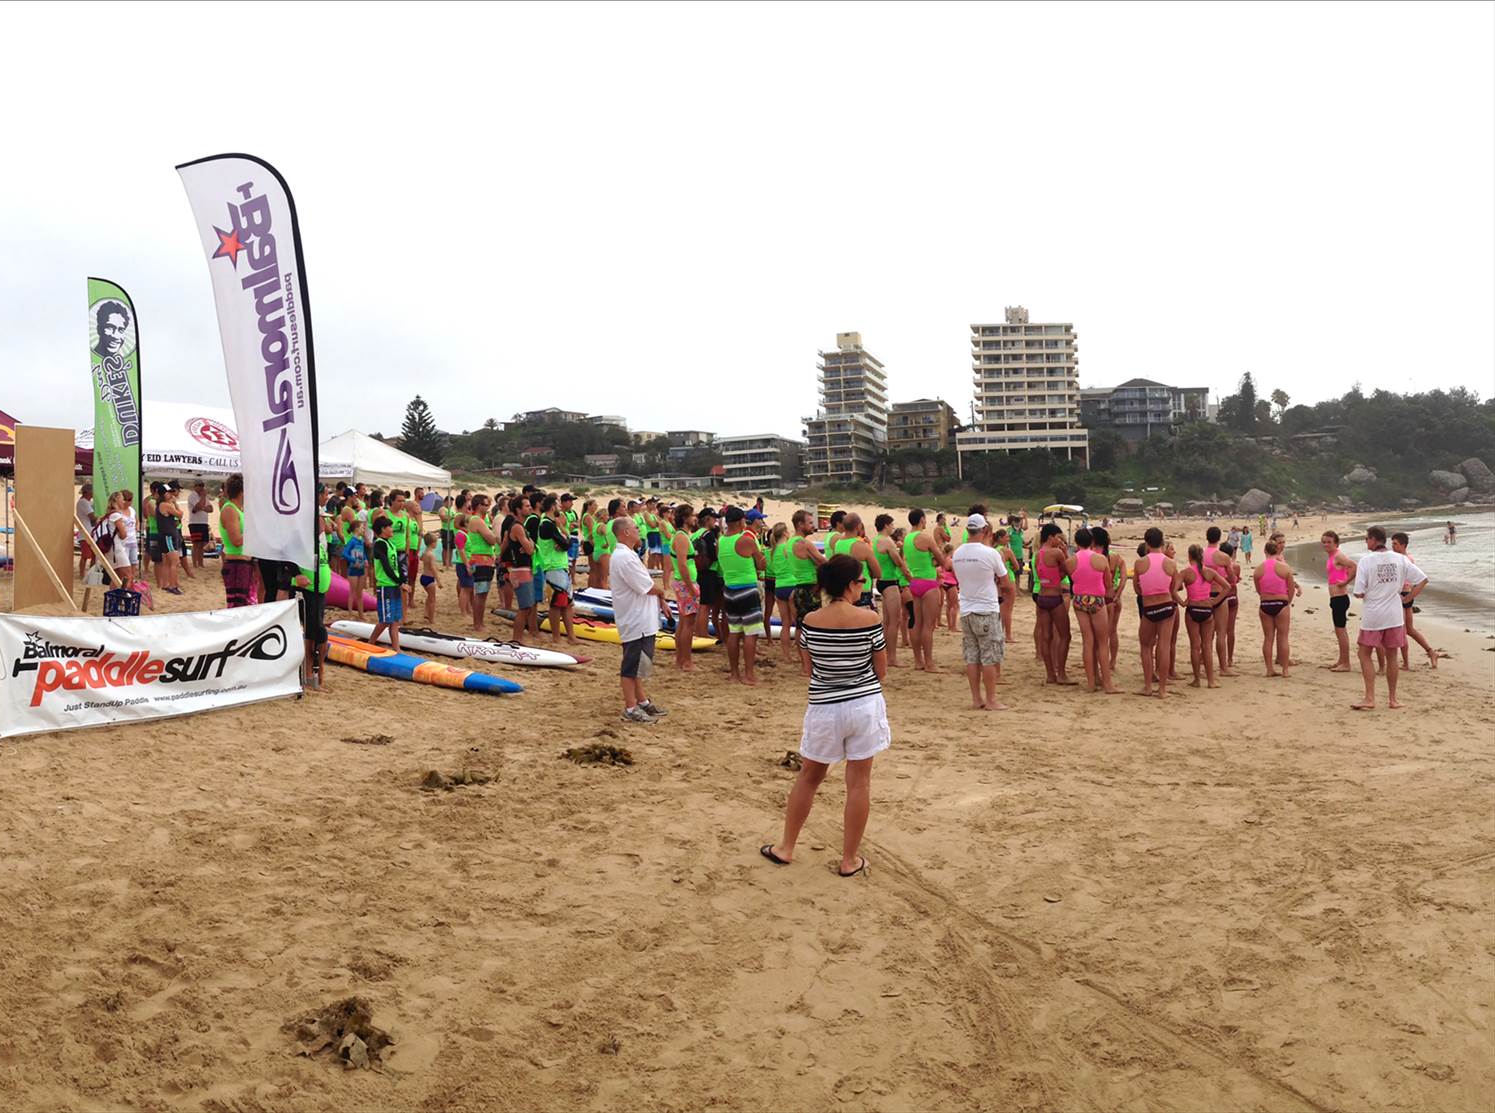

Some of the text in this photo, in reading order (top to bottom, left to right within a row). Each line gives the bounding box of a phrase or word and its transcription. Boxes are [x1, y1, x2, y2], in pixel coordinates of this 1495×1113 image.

[147, 454, 161, 462] EID
[164, 454, 202, 464] LAWYERS
[209, 458, 229, 466] CALL
[23, 641, 105, 660] Balmoral
[30, 639, 238, 707] paddlesurf
[64, 703, 82, 712] Just
[84, 700, 123, 709] StandUp
[125, 697, 149, 706] Paddle
